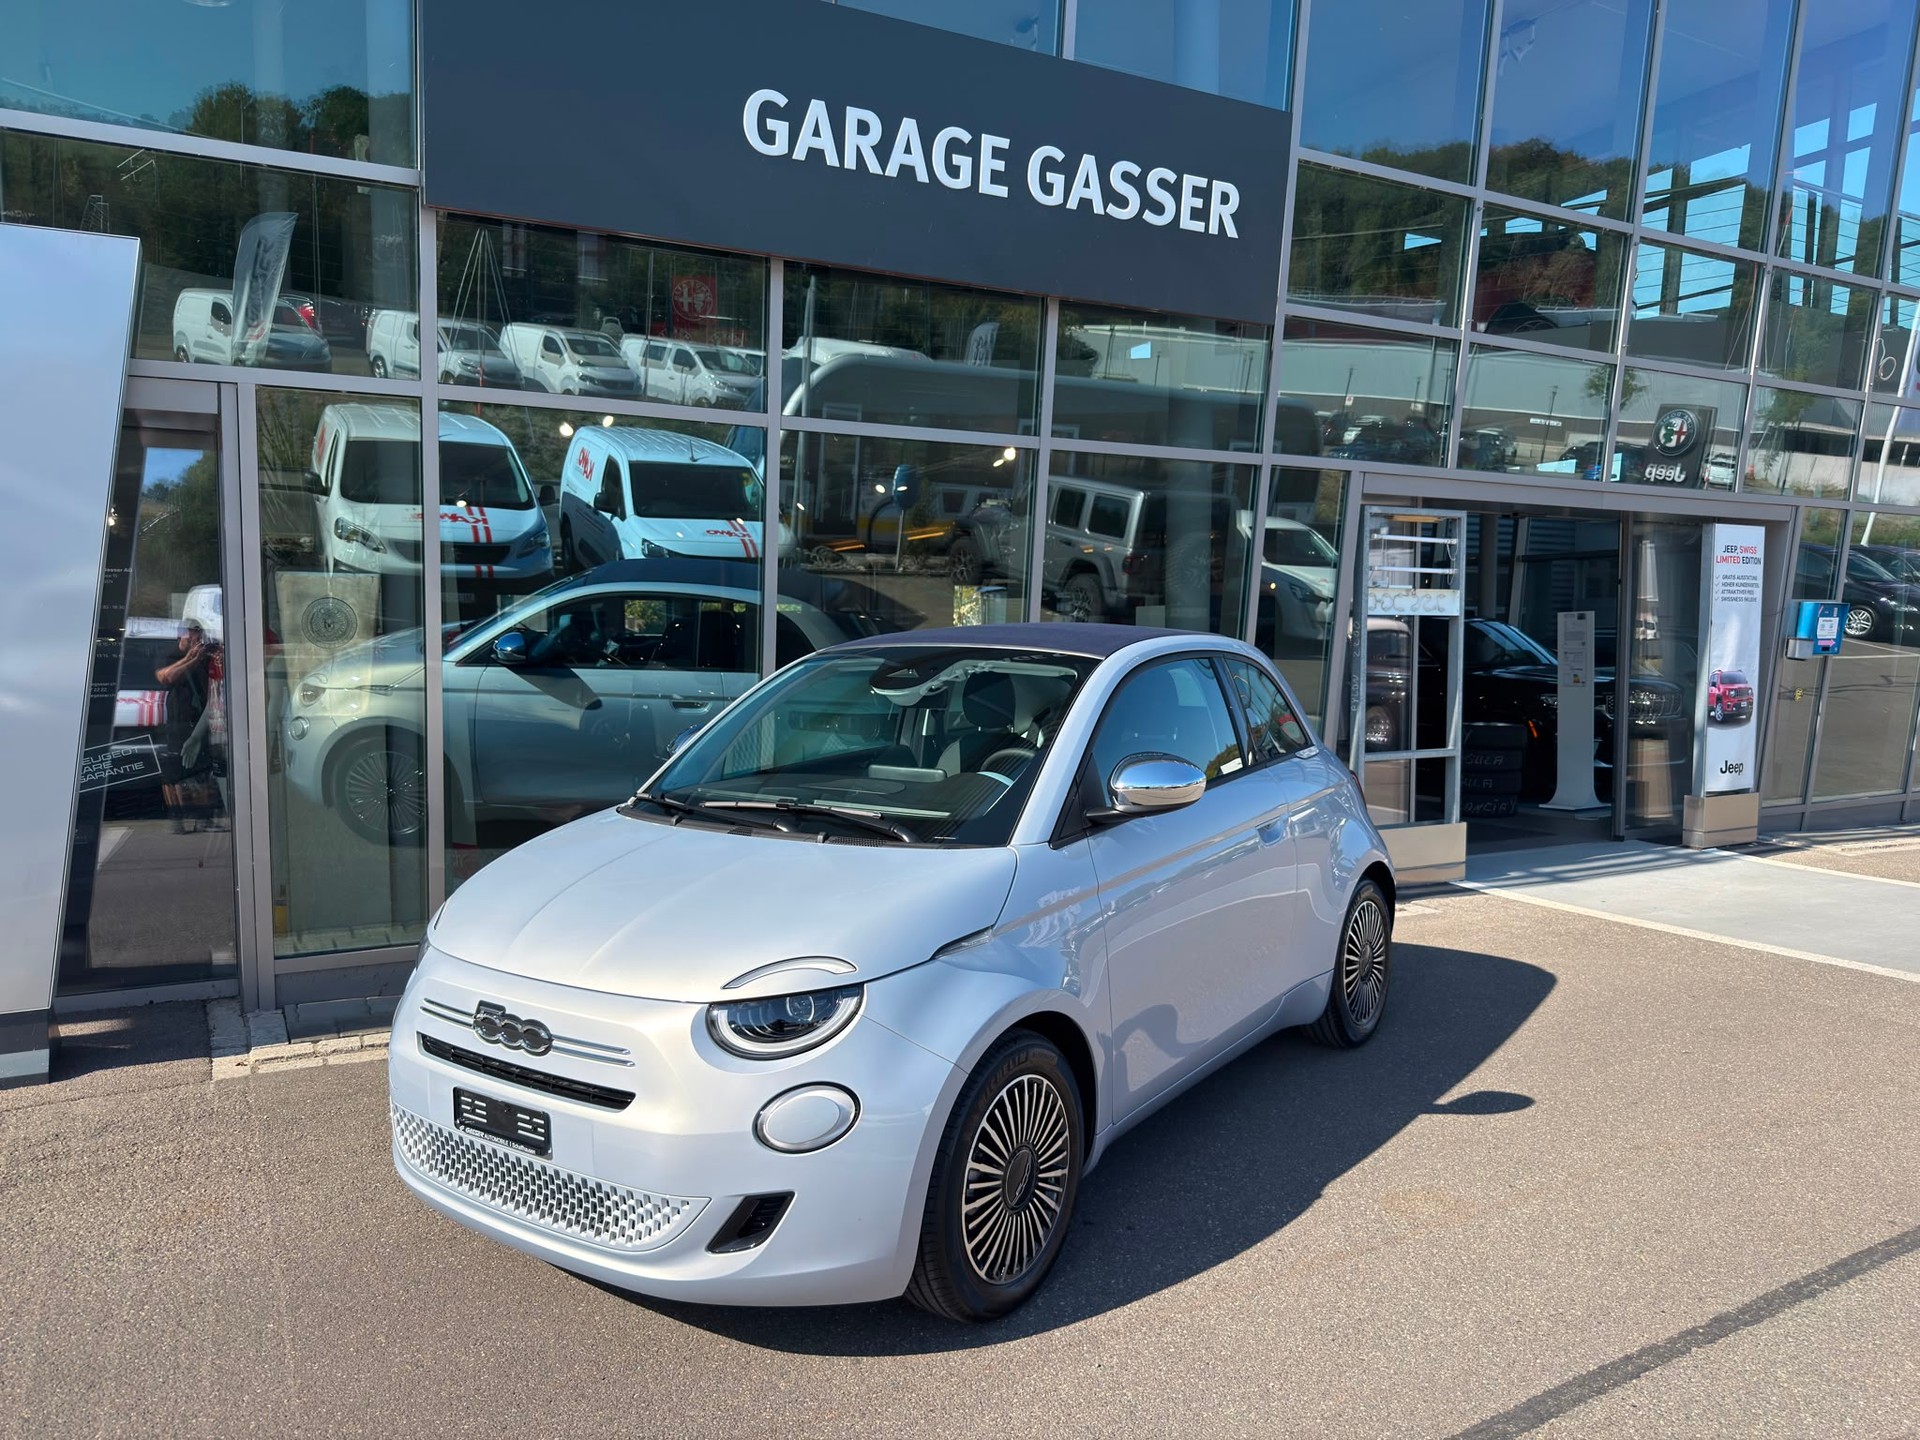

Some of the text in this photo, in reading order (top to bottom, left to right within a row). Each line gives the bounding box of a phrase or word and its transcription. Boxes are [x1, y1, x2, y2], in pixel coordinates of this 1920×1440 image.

[743, 89, 1240, 239] GARAGE GASSER
[1723, 545, 1757, 555] JEEP, SWISS
[1716, 555, 1762, 565] LIMITED EDITION
[82, 747, 139, 766] EUGEOT
[81, 761, 113, 774] ARE
[1720, 760, 1743, 775] Jeep
[474, 1000, 553, 1057] 500
